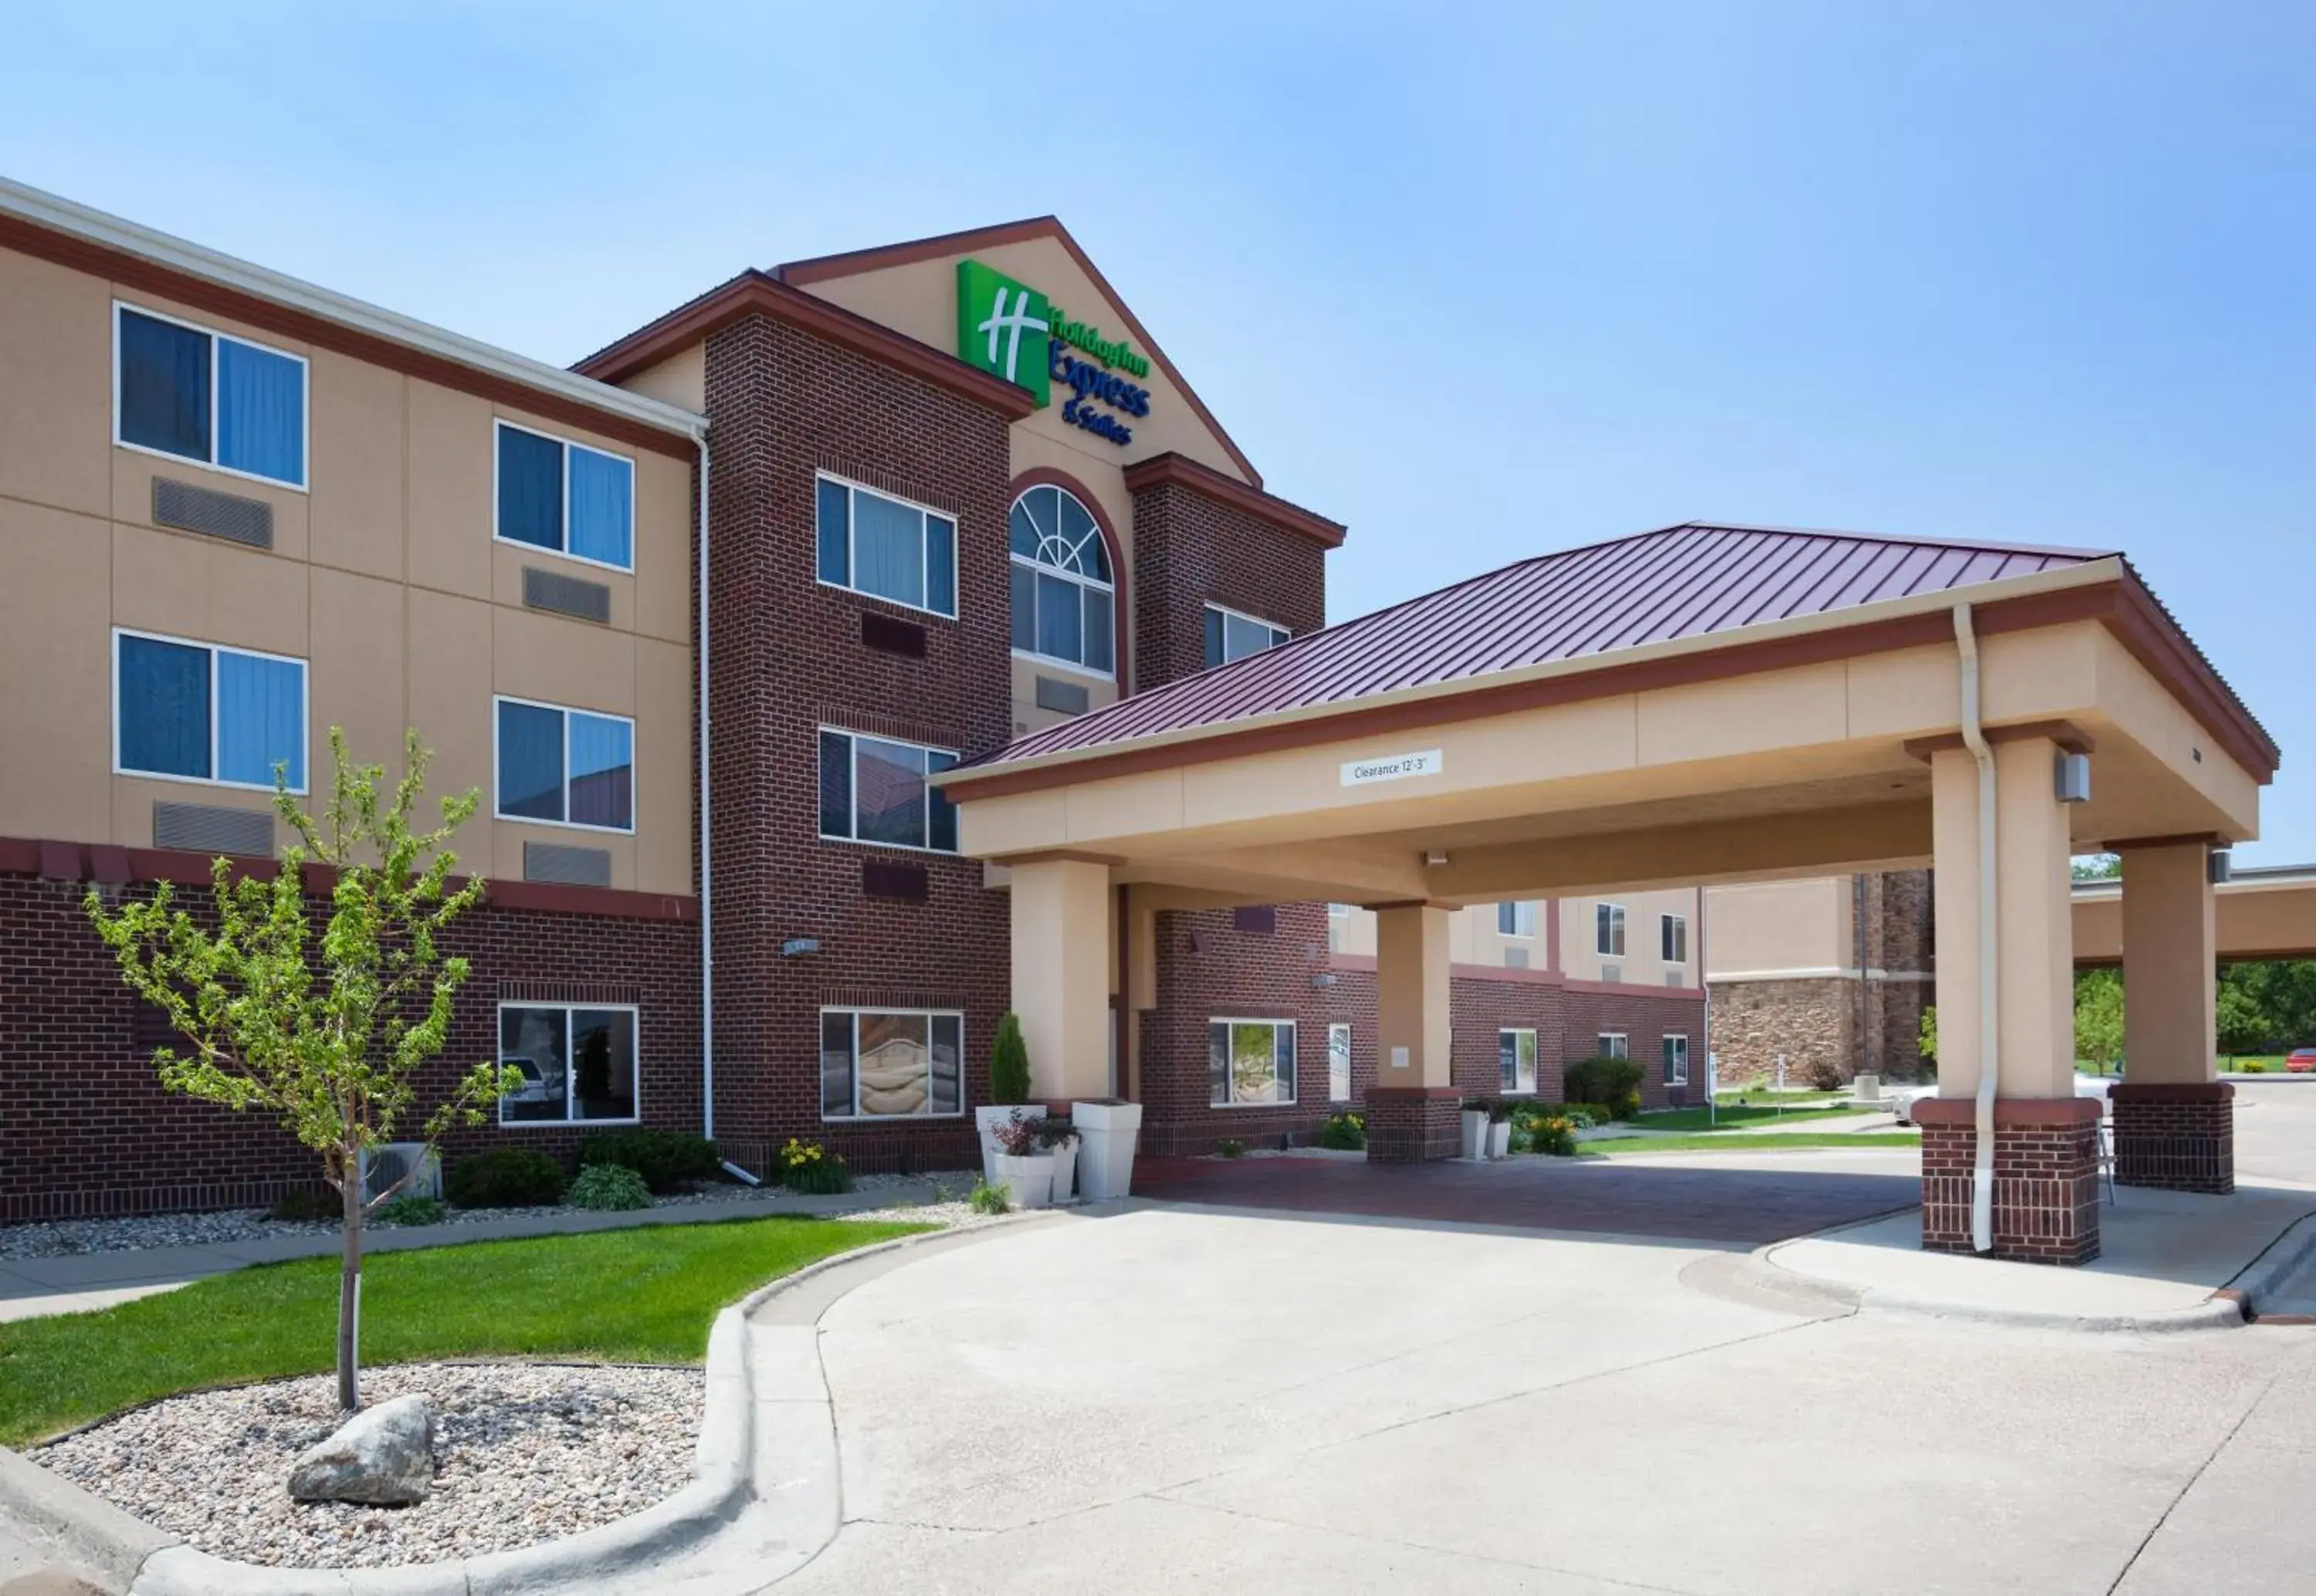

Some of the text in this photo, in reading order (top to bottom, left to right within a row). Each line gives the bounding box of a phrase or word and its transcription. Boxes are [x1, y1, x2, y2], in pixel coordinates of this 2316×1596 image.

[1048, 306, 1150, 379] Holiday Inn
[1048, 339, 1151, 418] Express
[1354, 764, 1400, 779] Clearance
